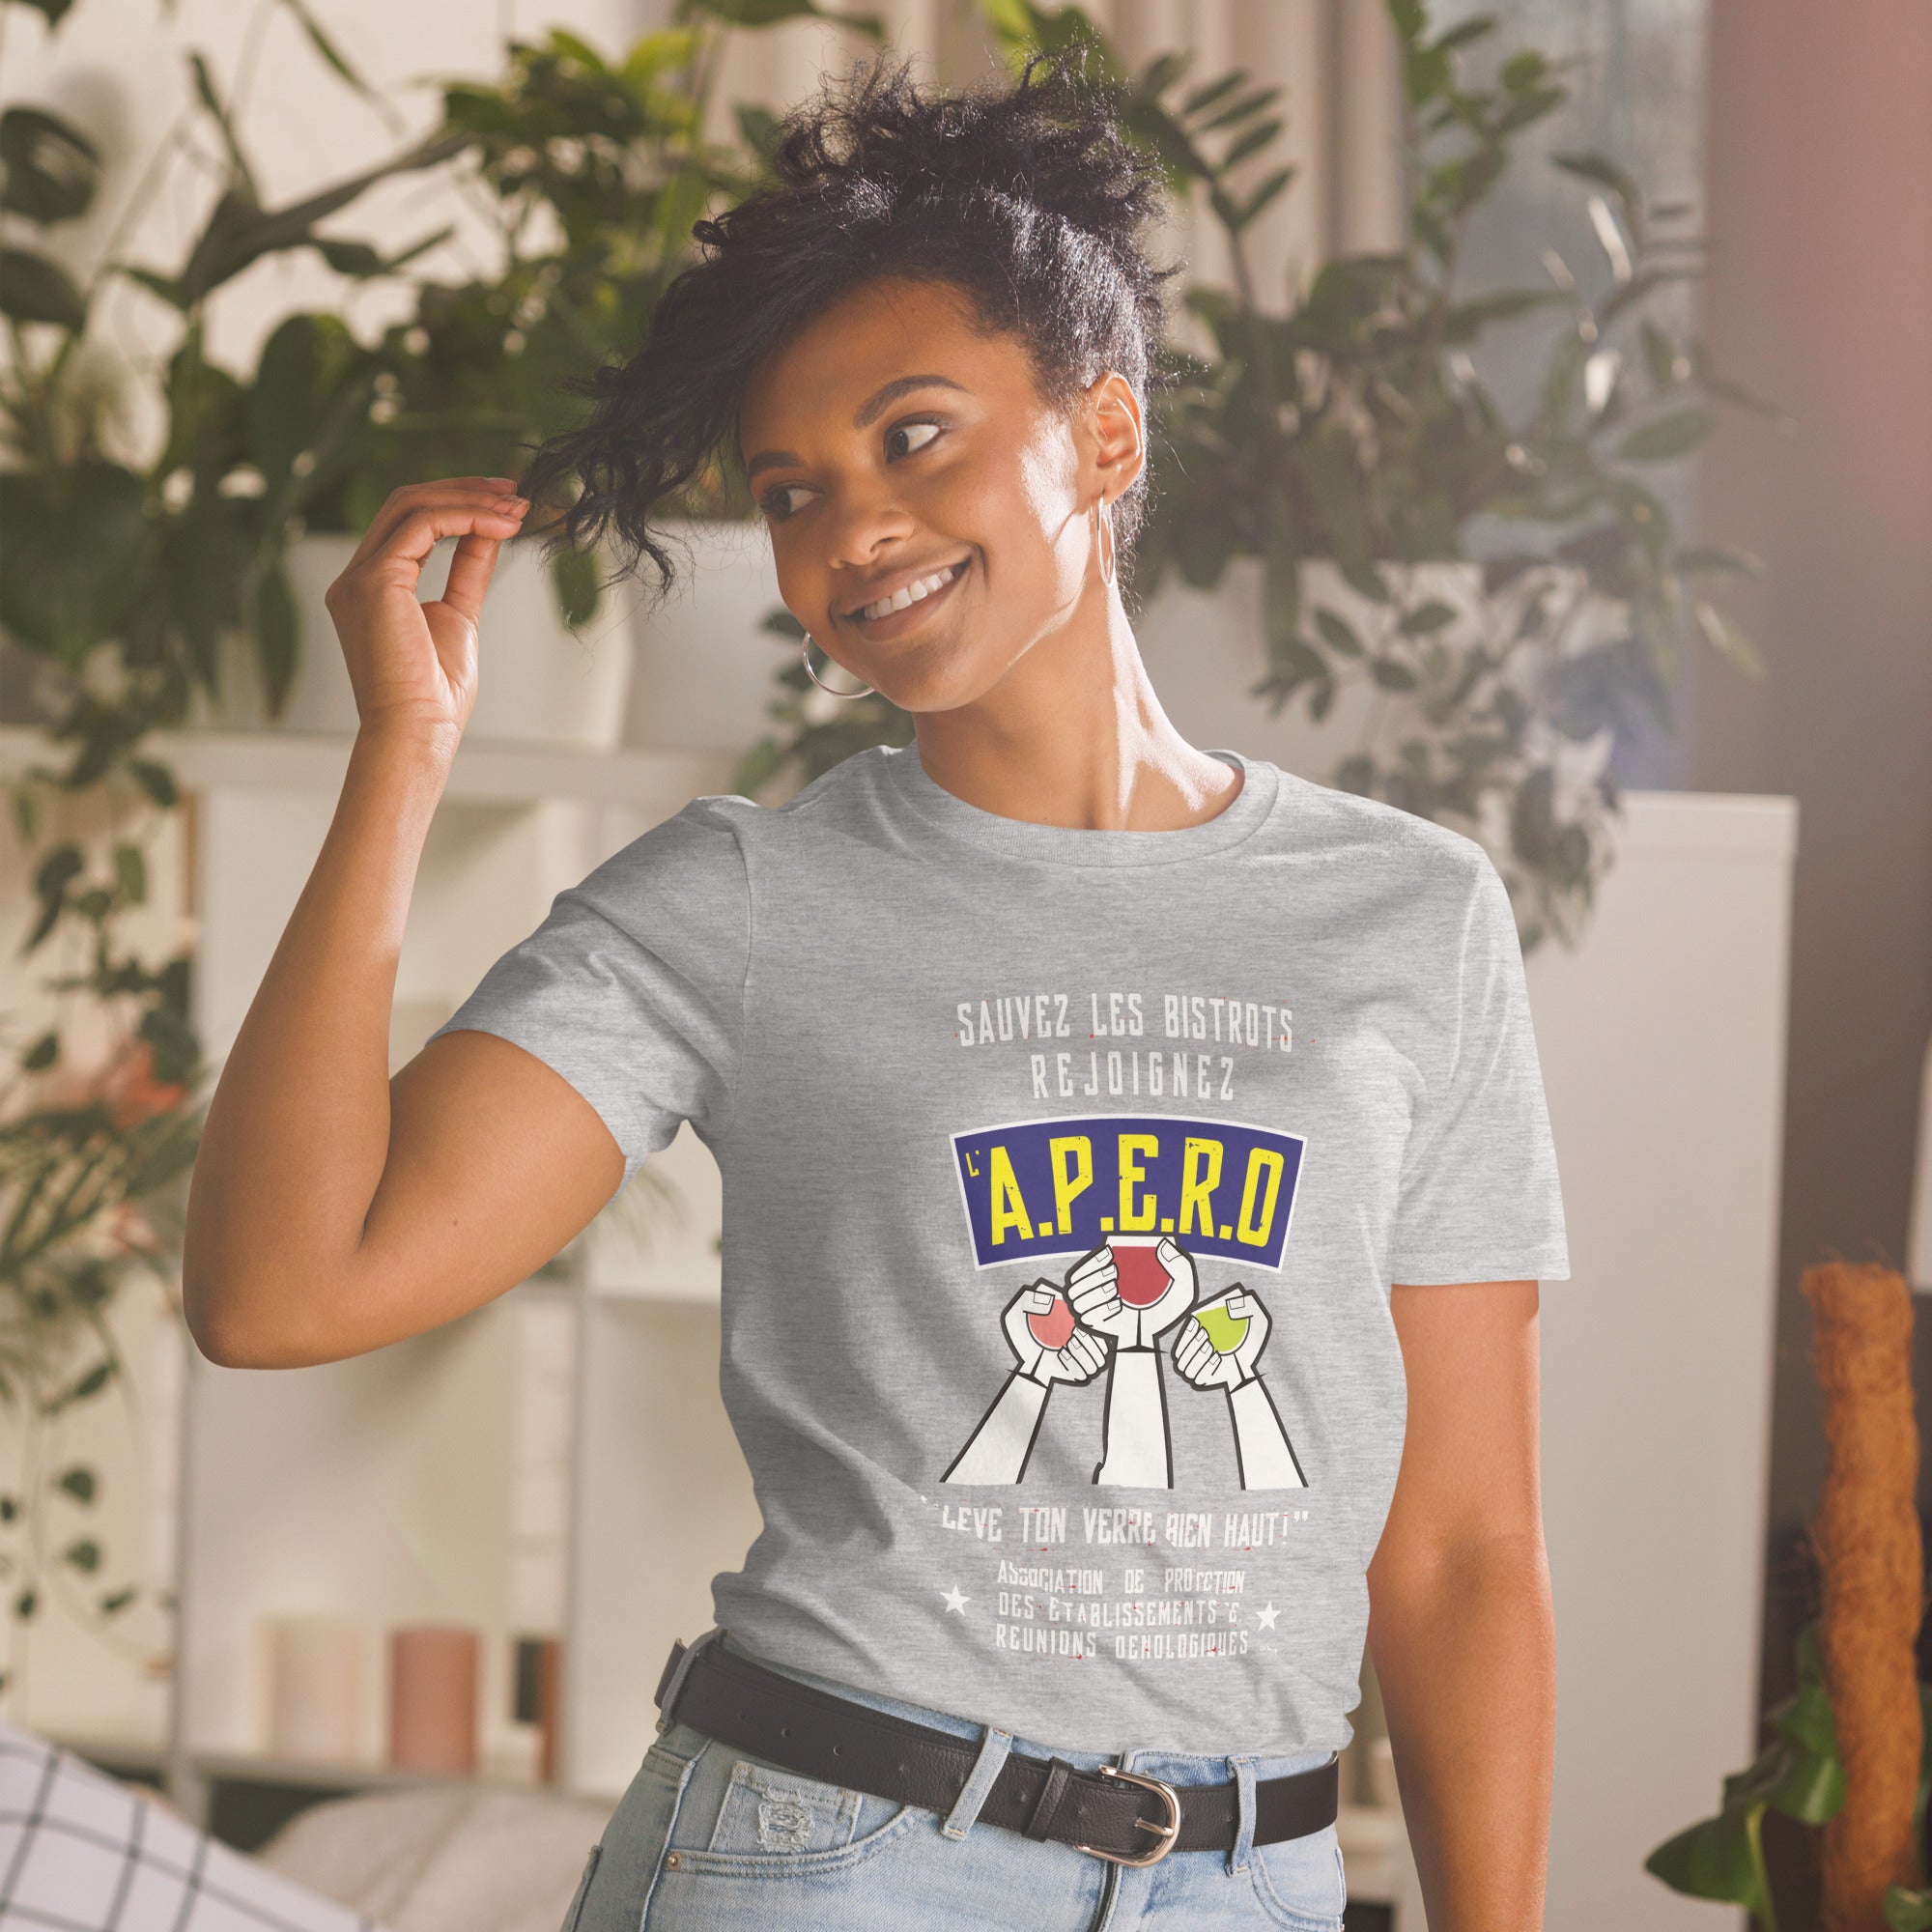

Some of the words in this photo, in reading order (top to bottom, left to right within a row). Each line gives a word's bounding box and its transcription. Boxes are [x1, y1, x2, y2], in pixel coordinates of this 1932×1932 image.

[957, 994, 1070, 1046] SAUVEZ
[1092, 993, 1143, 1037] LES
[1164, 994, 1293, 1052] BISTROTS
[1031, 1051, 1235, 1101] REJOIGNEZ
[1019, 1507, 1066, 1543] TON
[1083, 1507, 1156, 1544] VERRE
[1165, 1512, 1212, 1548] BIEN
[997, 1560, 1103, 1595] ASSOCIATION
[1124, 1569, 1145, 1594] DE
[999, 1591, 1035, 1620] DES
[1049, 1596, 1217, 1628] ETABLISSEMENTS
[996, 1623, 1096, 1658] REUNIONS
[1116, 1630, 1249, 1660] OENOLOGIQUES
